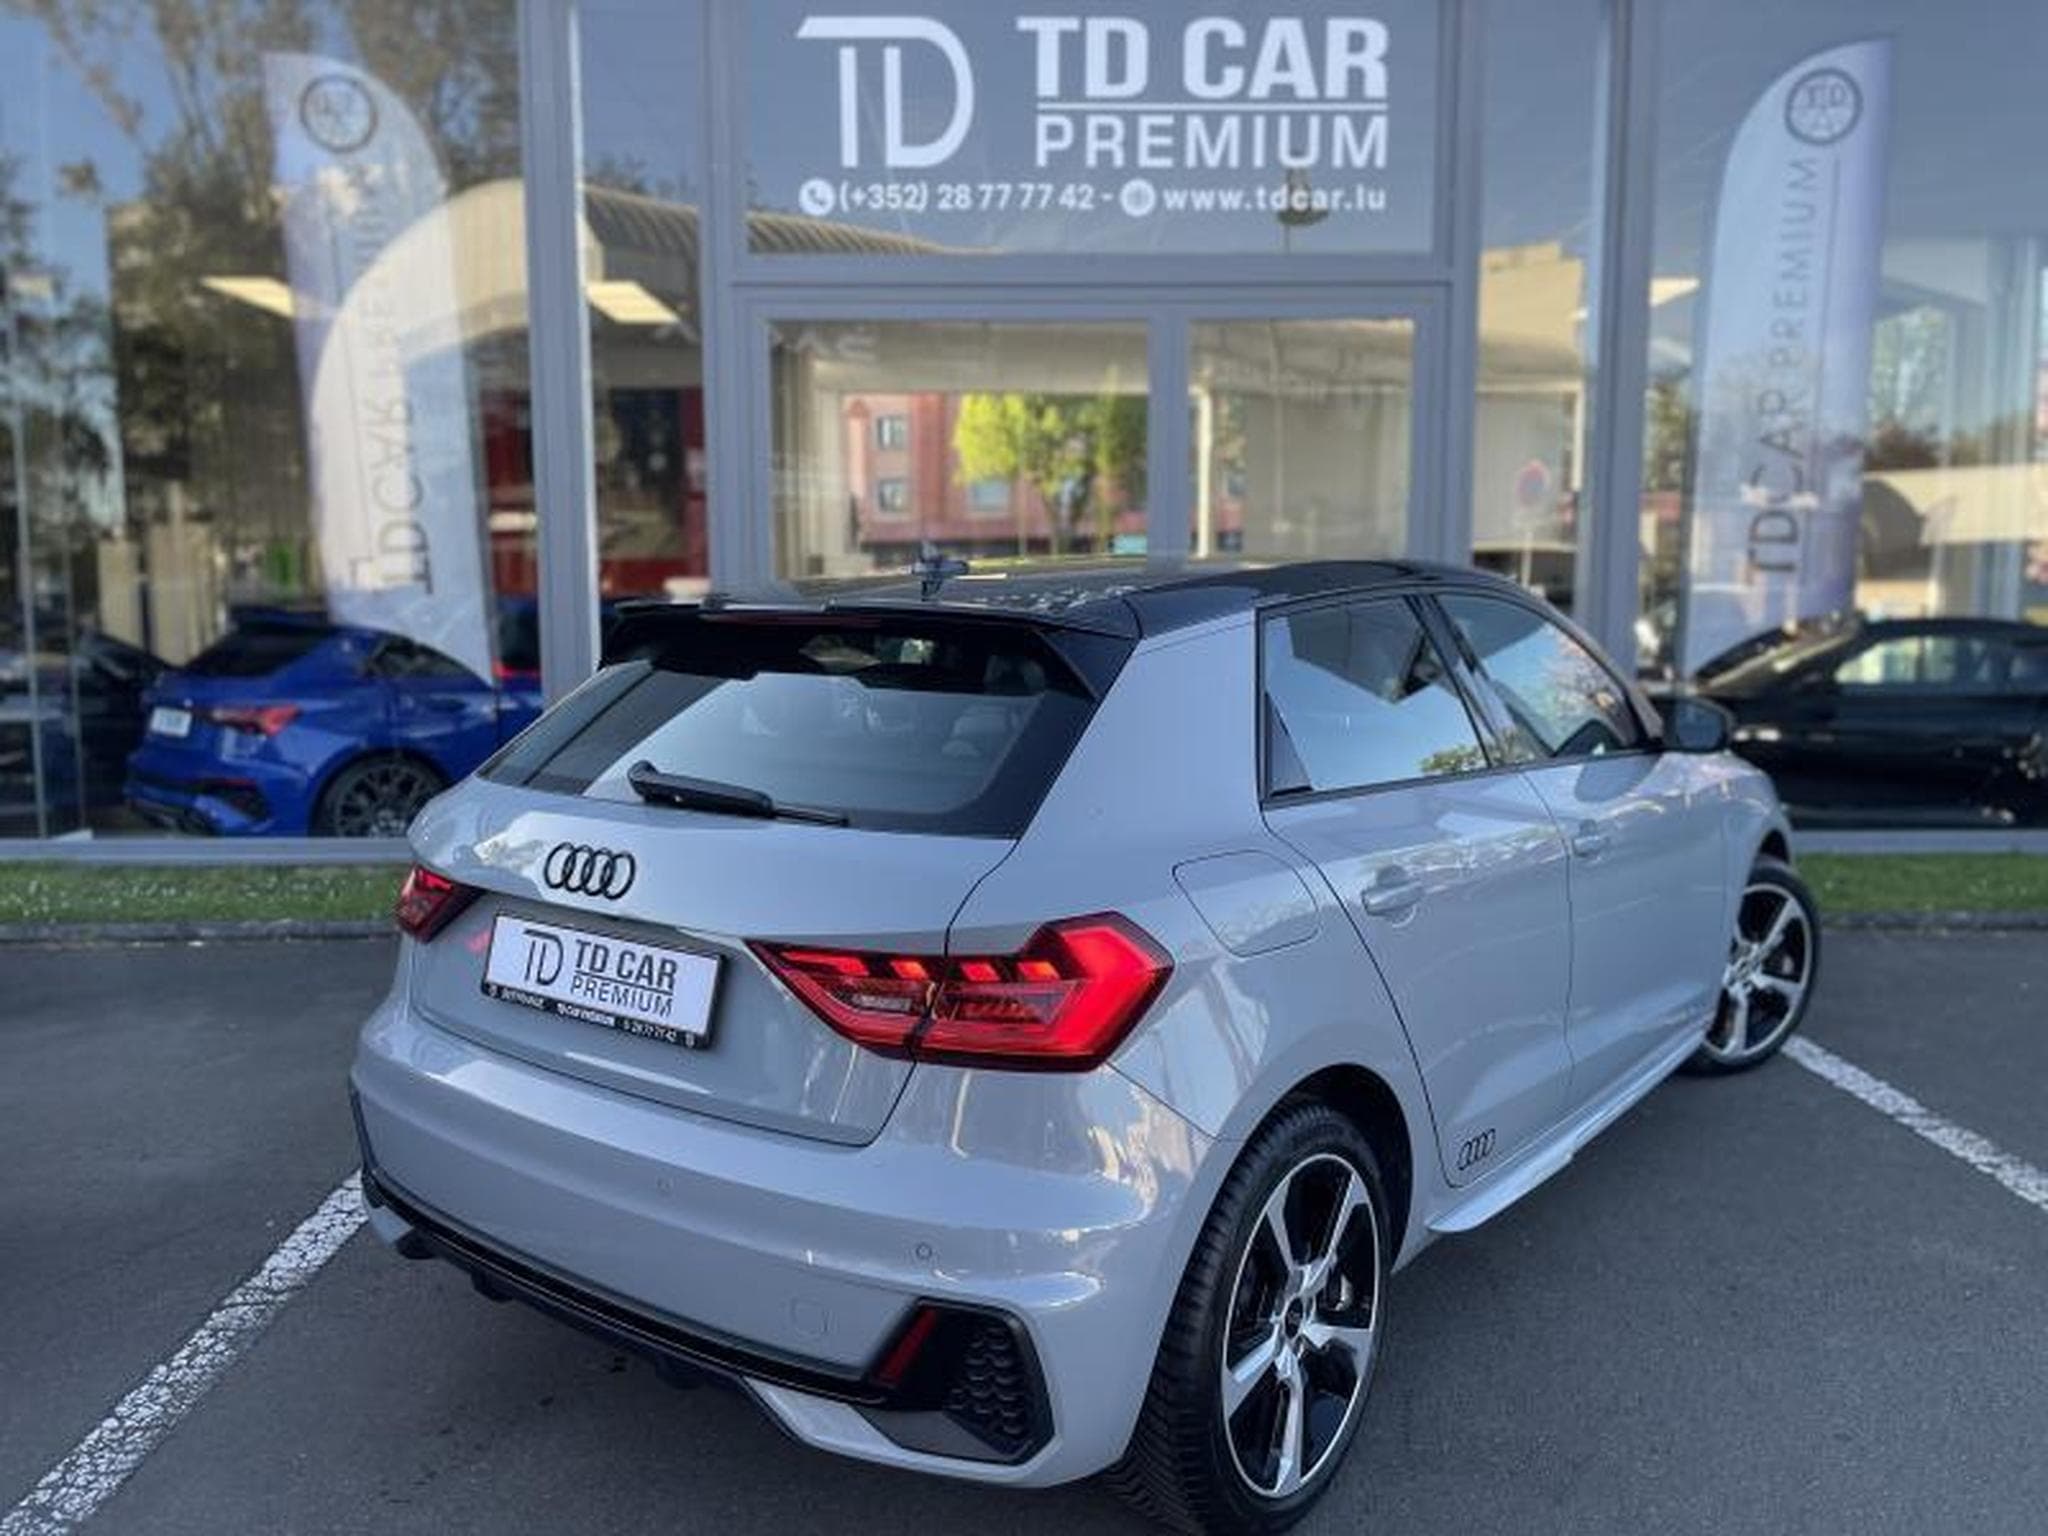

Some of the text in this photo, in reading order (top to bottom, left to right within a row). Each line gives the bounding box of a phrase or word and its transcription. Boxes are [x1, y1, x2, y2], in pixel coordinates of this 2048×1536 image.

[1018, 17, 1388, 98] TD CAR
[1037, 115, 1388, 168] PREMIUM
[840, 181, 928, 212] (+352)
[1162, 184, 1387, 211] www.tdcar.lu
[576, 939, 677, 991] TD CAR
[570, 975, 673, 1018] PREMIUM
